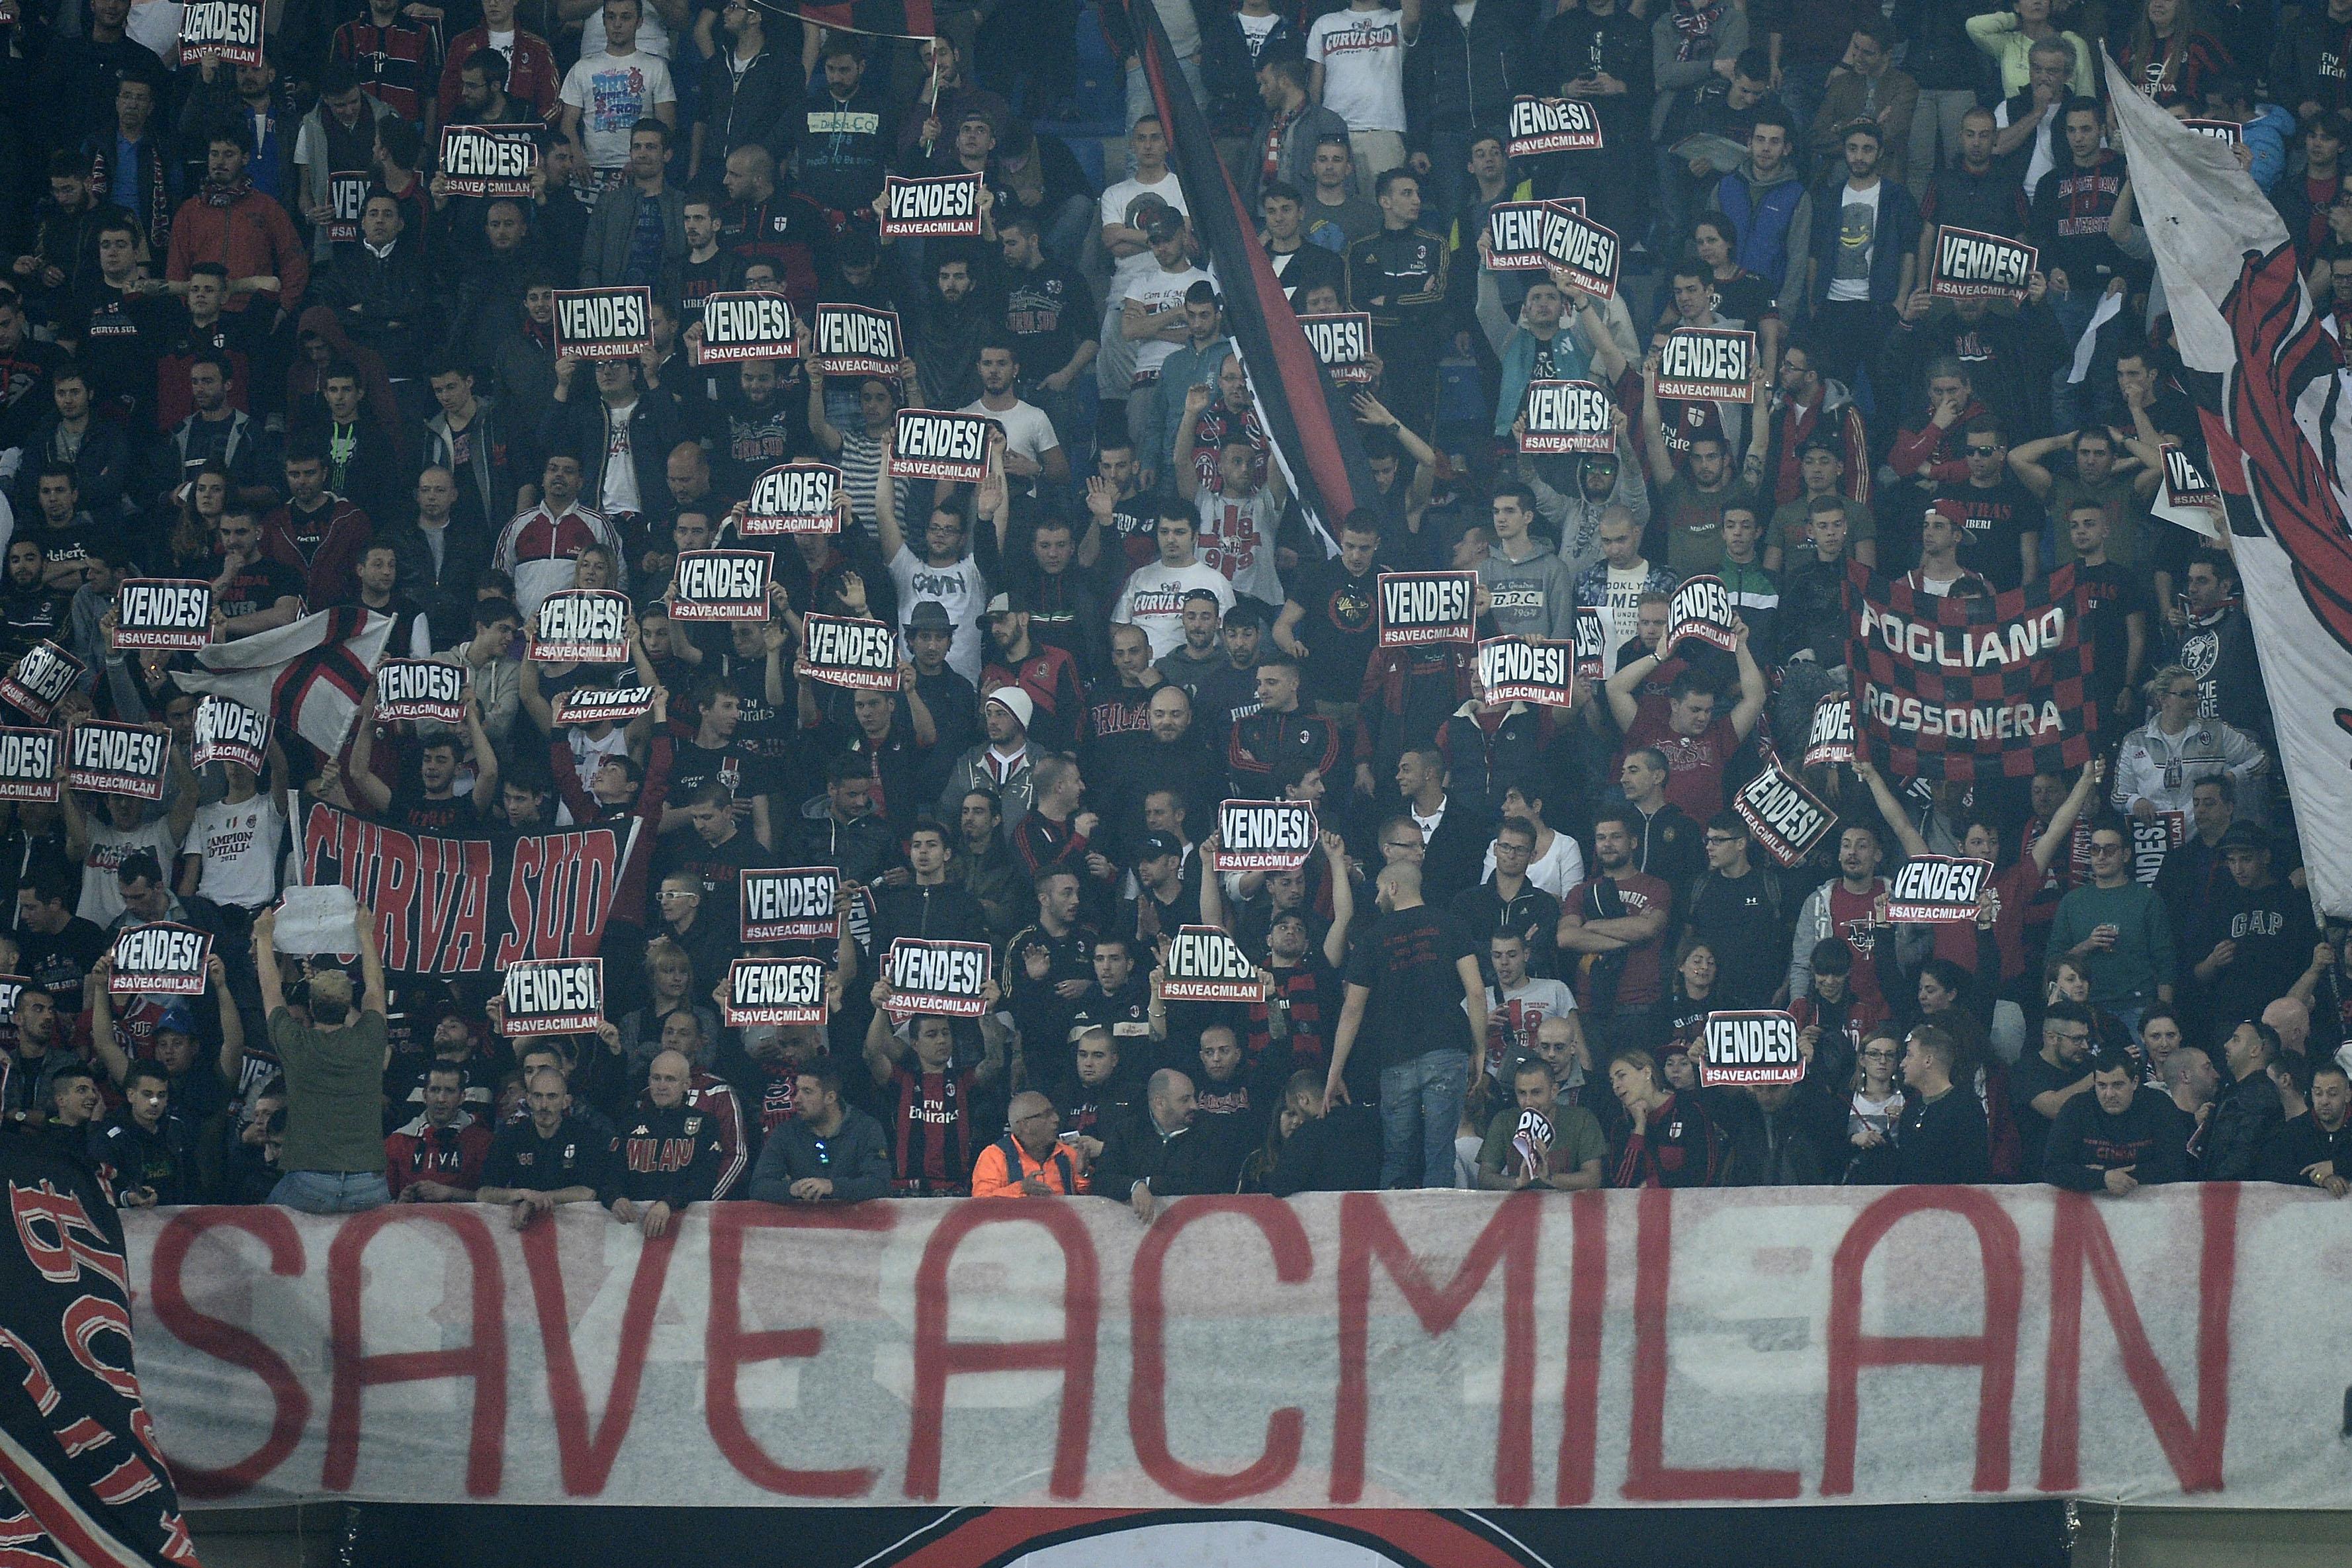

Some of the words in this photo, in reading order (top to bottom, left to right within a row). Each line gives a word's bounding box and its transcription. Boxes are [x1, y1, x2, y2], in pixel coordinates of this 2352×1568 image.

[185, 3, 256, 44] VENDESI
[1325, 33, 1366, 52] CURVA
[1368, 30, 1393, 46] SUD
[2322, 52, 2339, 65] Fly
[1509, 101, 1590, 138] VENDESI
[447, 134, 529, 176] VENDESI
[1509, 134, 1594, 153] #SAVEACMILAN
[889, 182, 974, 218] VENDESI
[886, 222, 973, 234] #SAVEACMILAN
[1544, 217, 1614, 277] VENDESI
[1942, 236, 2028, 285] VENDESI
[558, 296, 645, 338] VENDESI
[705, 300, 791, 342] VENDESI
[820, 312, 895, 357] VENDESI
[704, 345, 791, 360] #SAVEACMILAN
[1663, 337, 1746, 380] VENDESI
[1658, 382, 1746, 398] #SAVEACMILAN
[1529, 389, 1609, 431] VENDESI
[898, 417, 985, 460] VENDESI
[1525, 436, 1608, 449] #SAVEACMILAN
[893, 462, 980, 478] #SAVEACMILAN
[750, 471, 834, 515] VENDESI
[746, 516, 833, 531] #SAVEACMILAN
[679, 557, 763, 599] VENDESI
[122, 588, 209, 627] VENDESI
[539, 598, 625, 640] VENDESI
[675, 603, 762, 618] #SAVEACMILAN
[1133, 595, 1171, 612] CURVA
[1385, 580, 1469, 623] VENDESI
[1668, 582, 1733, 634] VENDESI
[118, 631, 205, 646] #SAVEACMILAN
[535, 644, 622, 658] #SAVEACMILAN
[808, 623, 898, 669] VENDESI
[1385, 627, 1469, 642] #SAVEACMILAN
[1484, 643, 1565, 686] VENDESI
[196, 700, 267, 749] VENDESI
[561, 707, 647, 720] #SAVEACMILAN
[1864, 683, 2066, 740] ROSSONERA
[75, 728, 161, 775] VENDESI
[195, 745, 260, 767] #SAVEACMILAN
[69, 773, 155, 795] #SAVEACMILAN
[681, 775, 705, 784] Gate
[1221, 808, 1309, 848] VENDESI
[304, 803, 492, 973] CURVA
[496, 829, 617, 971] SUD
[748, 876, 835, 920] VENDESI
[1894, 861, 1982, 901] VENDESI
[747, 922, 834, 938] #SAVEACMILAN
[1889, 906, 1975, 920] #SAVEACMILAN
[2231, 910, 2284, 938] GAP
[116, 932, 204, 971] VENDESI
[113, 977, 200, 990] #SAVEACMILAN
[735, 965, 821, 1004] VENDESI
[894, 947, 983, 994] VENDESI
[505, 967, 595, 1013] VENDESI
[889, 994, 980, 1013] #SAVEACMILAN
[1165, 982, 1258, 998] #SAVEACMILAN
[507, 1017, 597, 1033] #SAVEACMILAN
[732, 1009, 820, 1023] #SAVEACMILAN
[1705, 1020, 1798, 1063] VENDESI
[1706, 1069, 1798, 1081] #SAVEACMILAN
[909, 1106, 959, 1124] Emirates
[924, 1100, 943, 1111] Fly
[414, 1151, 462, 1169] VIVA
[627, 1137, 694, 1174] MILAN
